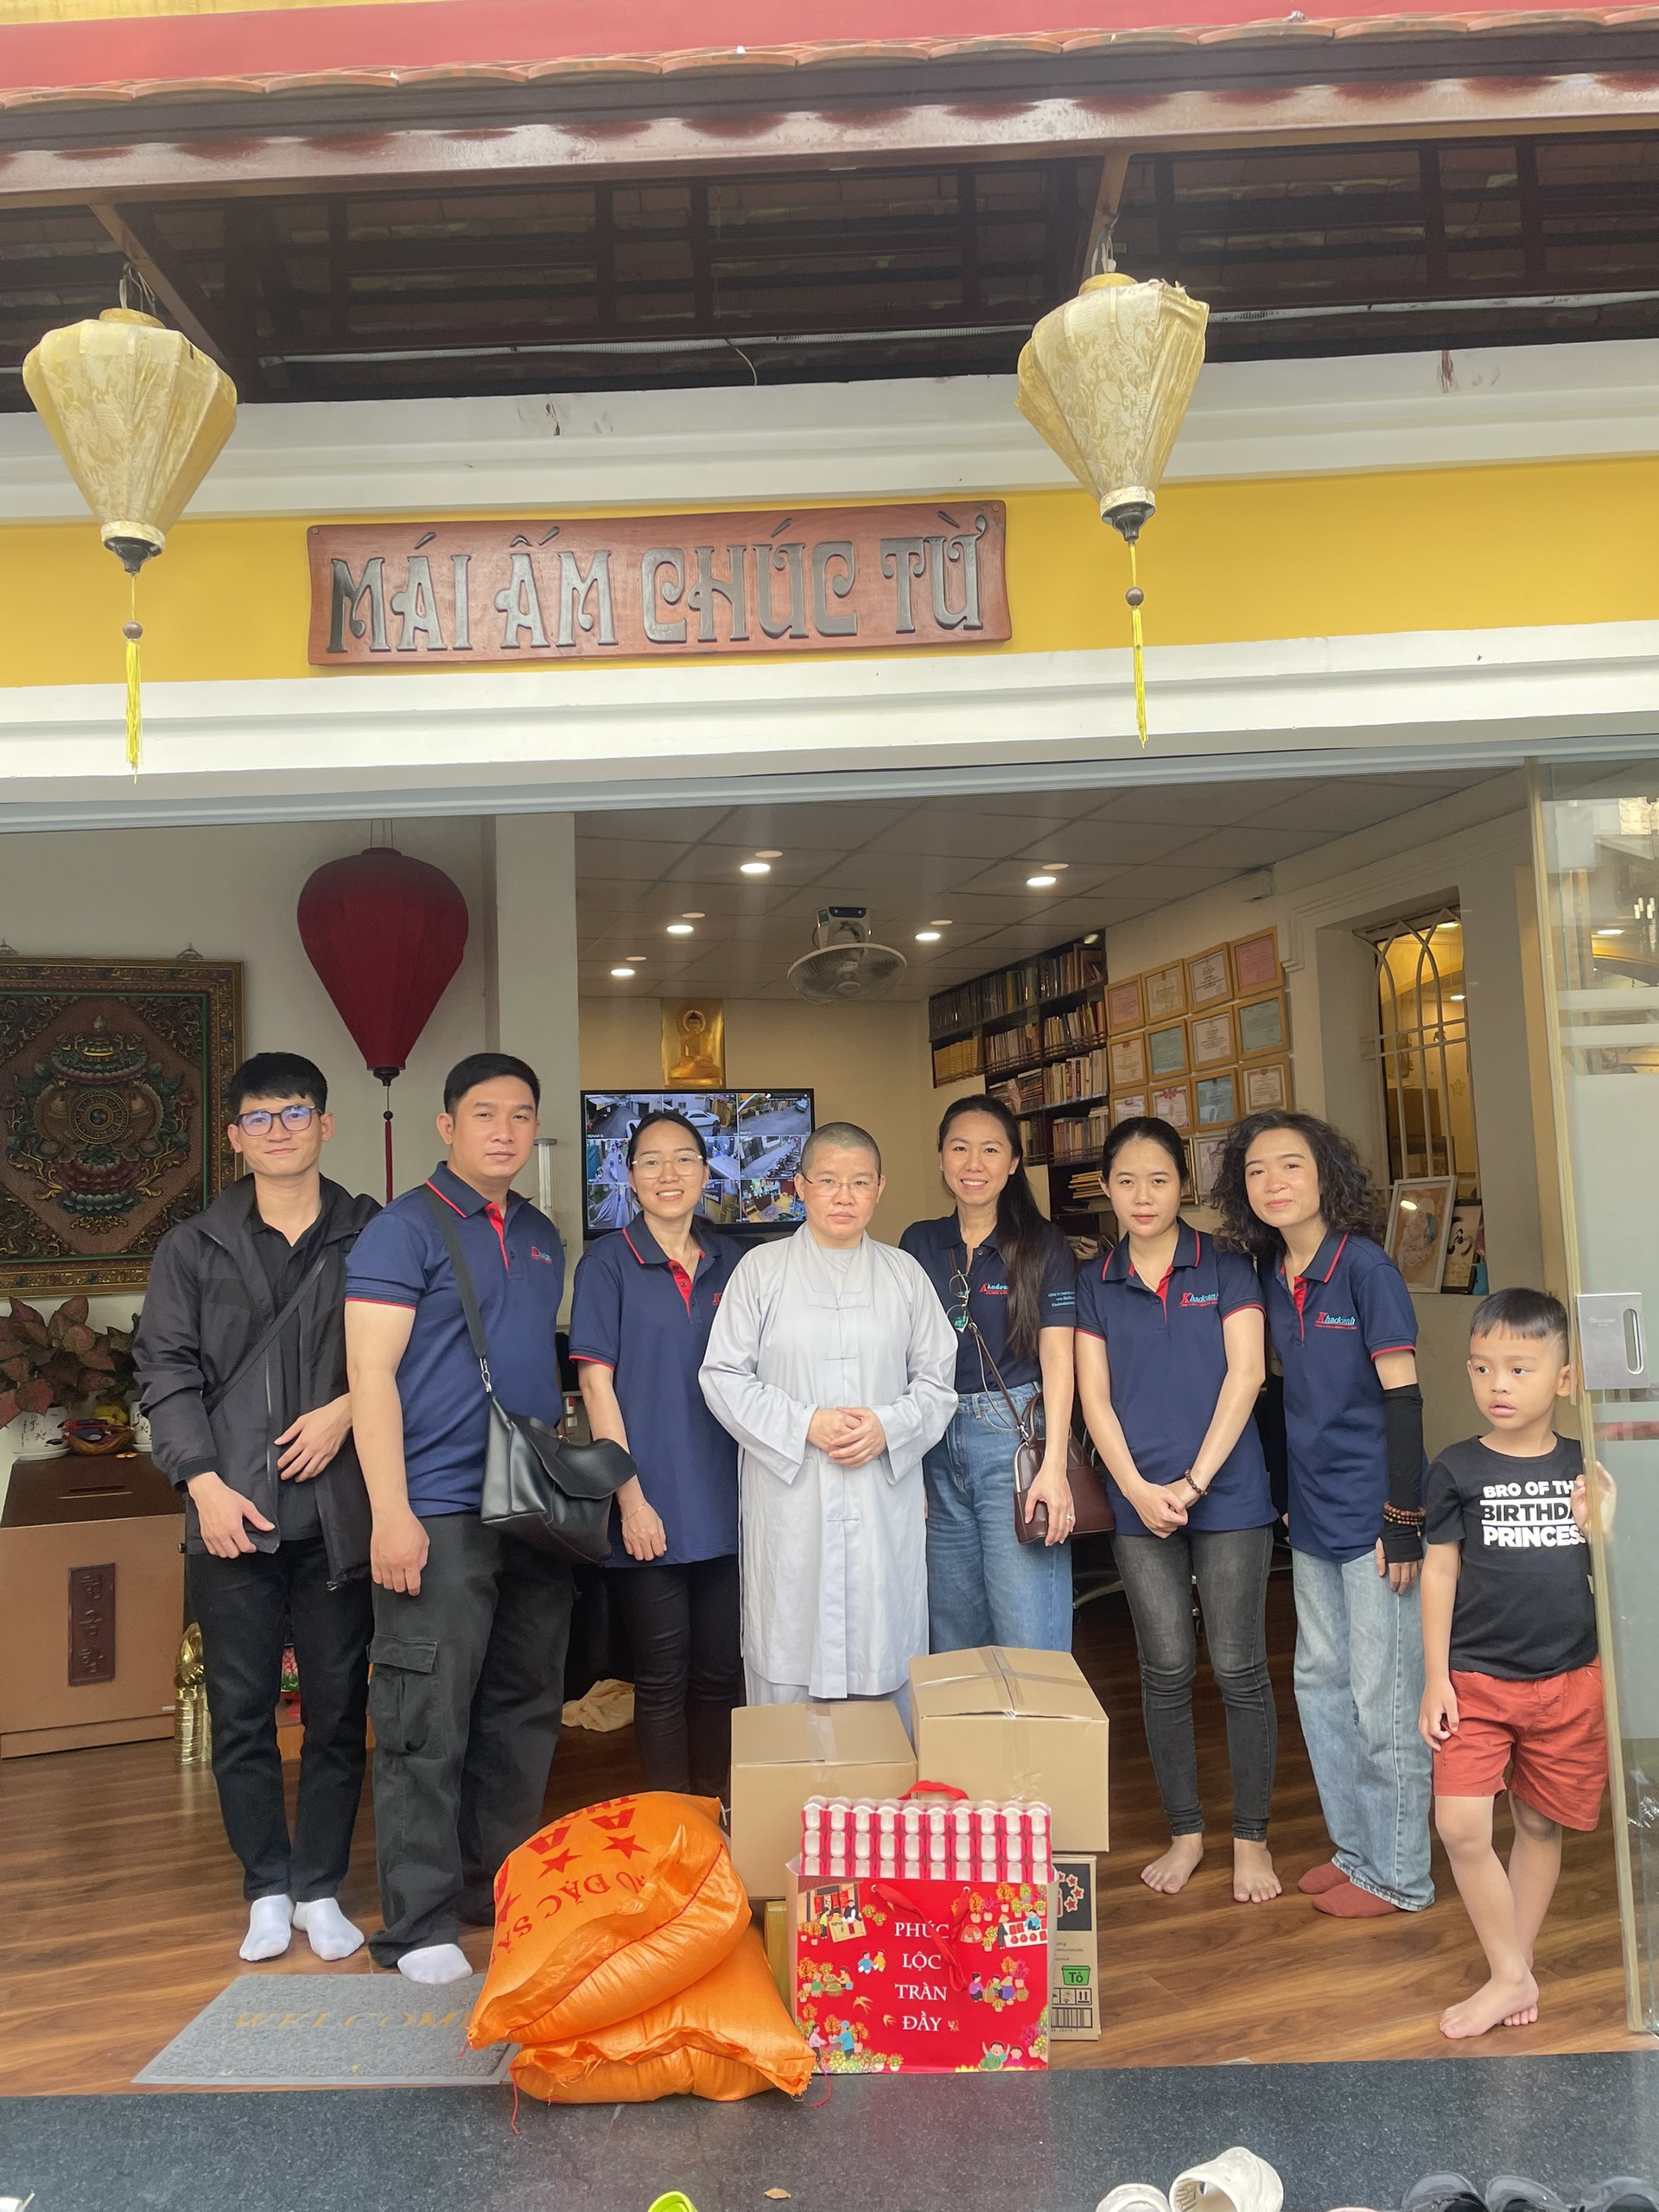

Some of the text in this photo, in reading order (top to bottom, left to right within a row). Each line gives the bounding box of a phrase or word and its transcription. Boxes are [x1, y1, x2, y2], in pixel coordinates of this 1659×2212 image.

[327, 511, 986, 653] MÁI ẤM CHÚC TỪ
[1483, 1480, 1576, 1498] BRO OF TH
[894, 1920, 950, 1939] PHÚC
[902, 1951, 942, 1971] LỘC
[1068, 1971, 1084, 1984] Tô
[894, 1982, 948, 2001] TRÀN
